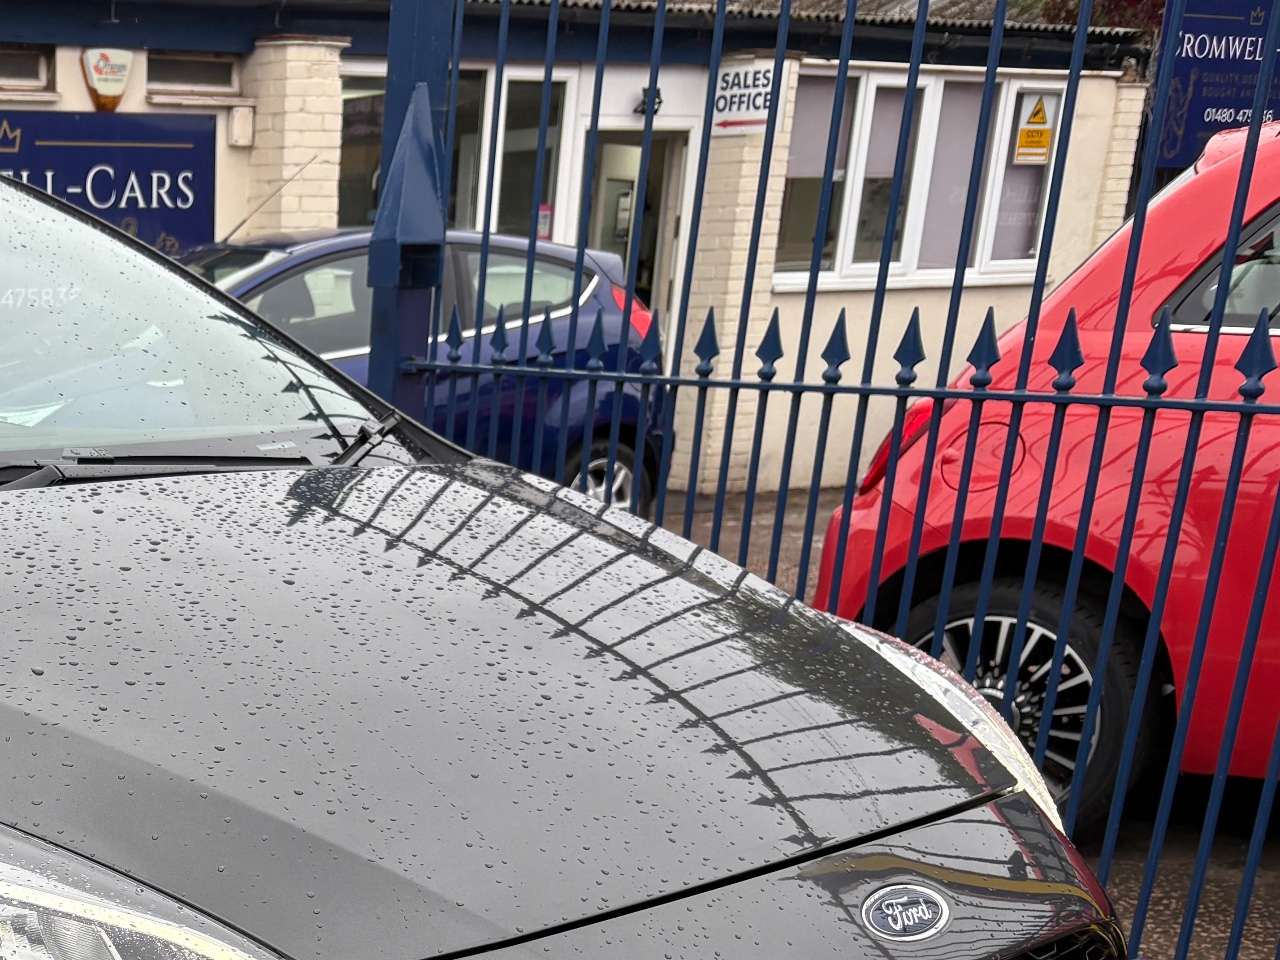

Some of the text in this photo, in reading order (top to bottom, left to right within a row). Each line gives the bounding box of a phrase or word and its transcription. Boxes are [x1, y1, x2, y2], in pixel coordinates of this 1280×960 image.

[721, 69, 771, 90] SALES
[716, 92, 771, 112] OFFICE
[1204, 107, 1234, 123] 01480
[881, 896, 933, 931] Ford
